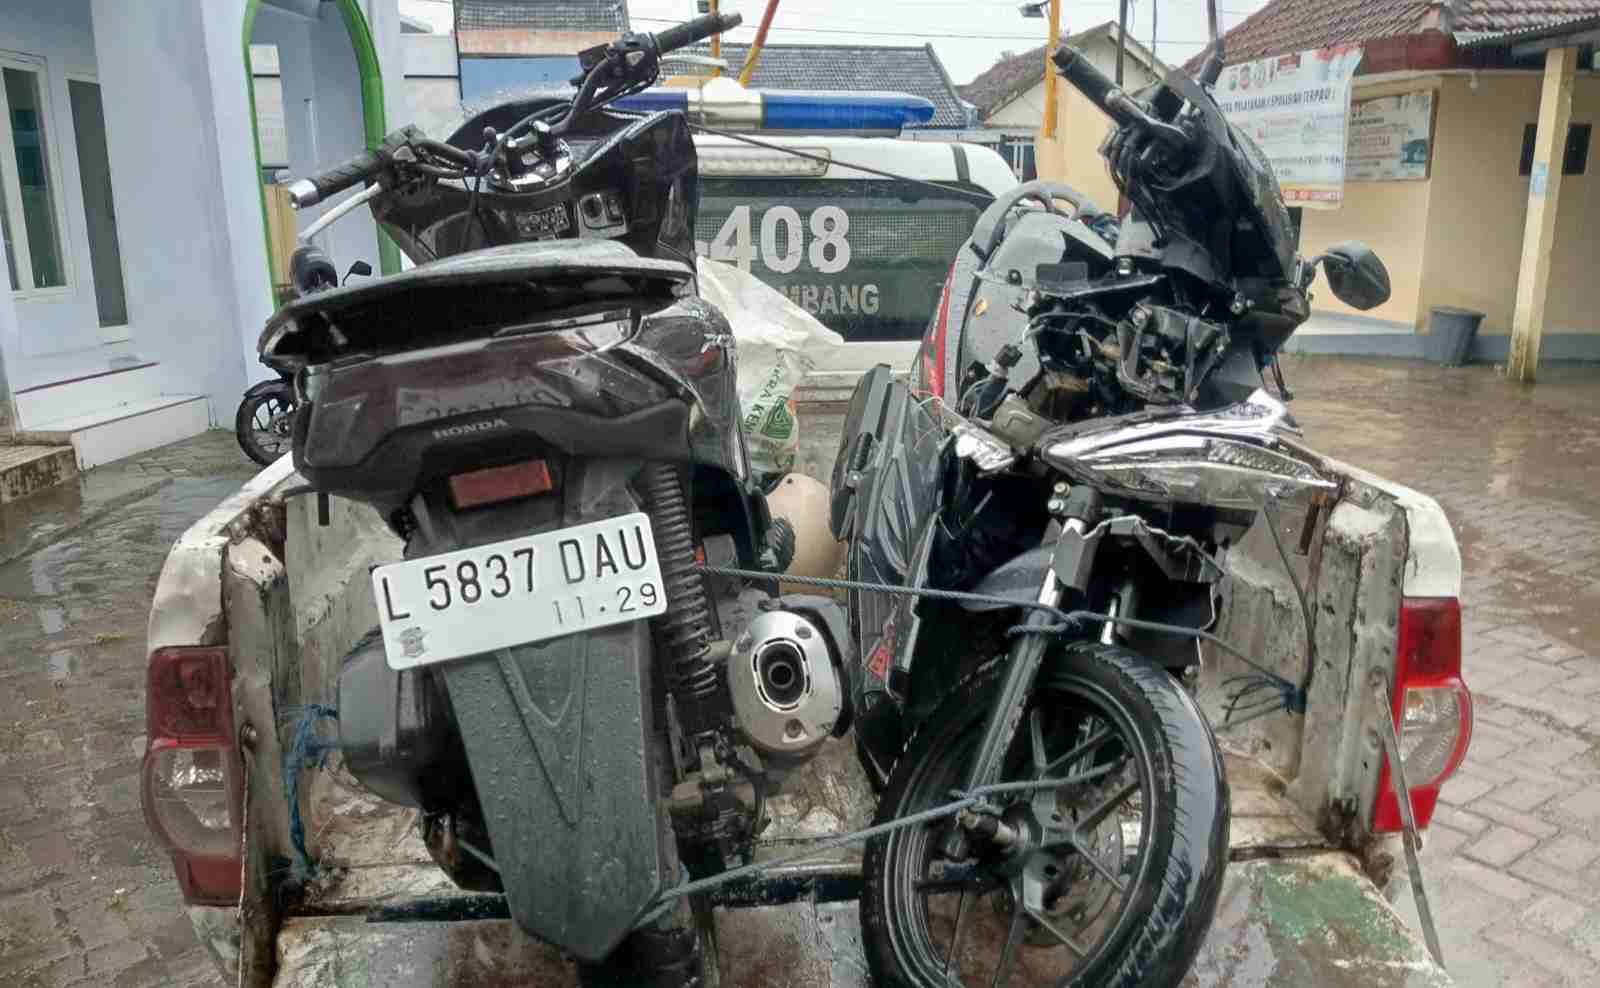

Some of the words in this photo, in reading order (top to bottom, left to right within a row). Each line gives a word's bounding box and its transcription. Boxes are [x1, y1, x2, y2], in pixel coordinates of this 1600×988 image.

[431, 418, 508, 440] HONDA
[382, 577, 410, 621] L
[424, 547, 535, 611] 5837
[558, 525, 648, 585] DAU
